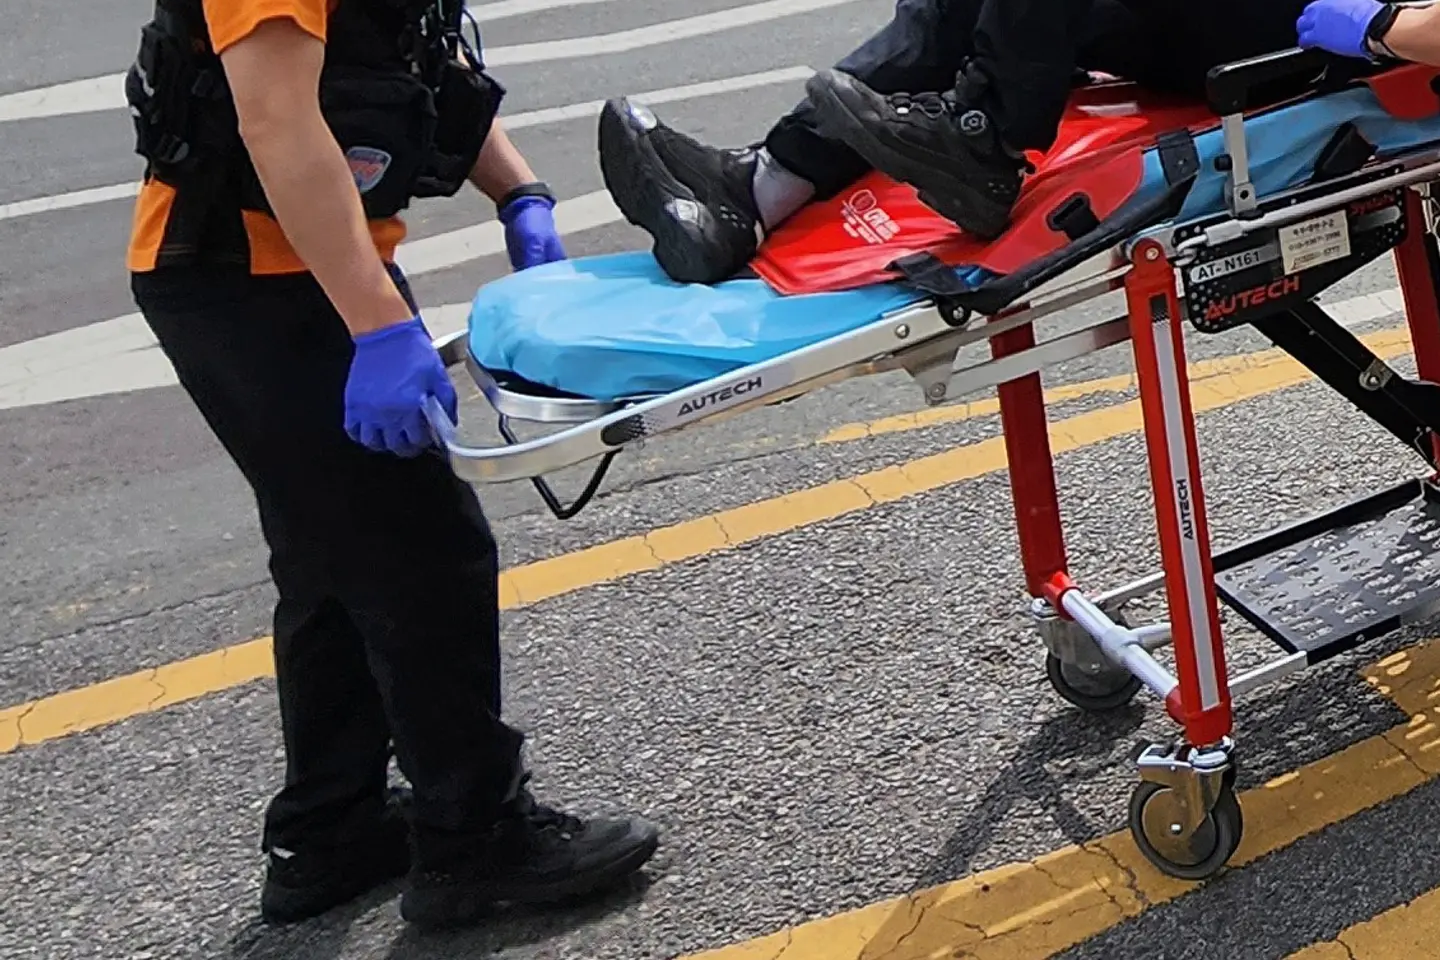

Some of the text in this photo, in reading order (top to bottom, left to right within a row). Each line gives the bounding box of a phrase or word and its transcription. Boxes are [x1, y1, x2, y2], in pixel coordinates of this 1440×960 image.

[1203, 275, 1301, 321] AUTECH
[676, 375, 763, 418] AUTECH
[1175, 477, 1195, 541] AUTECH
